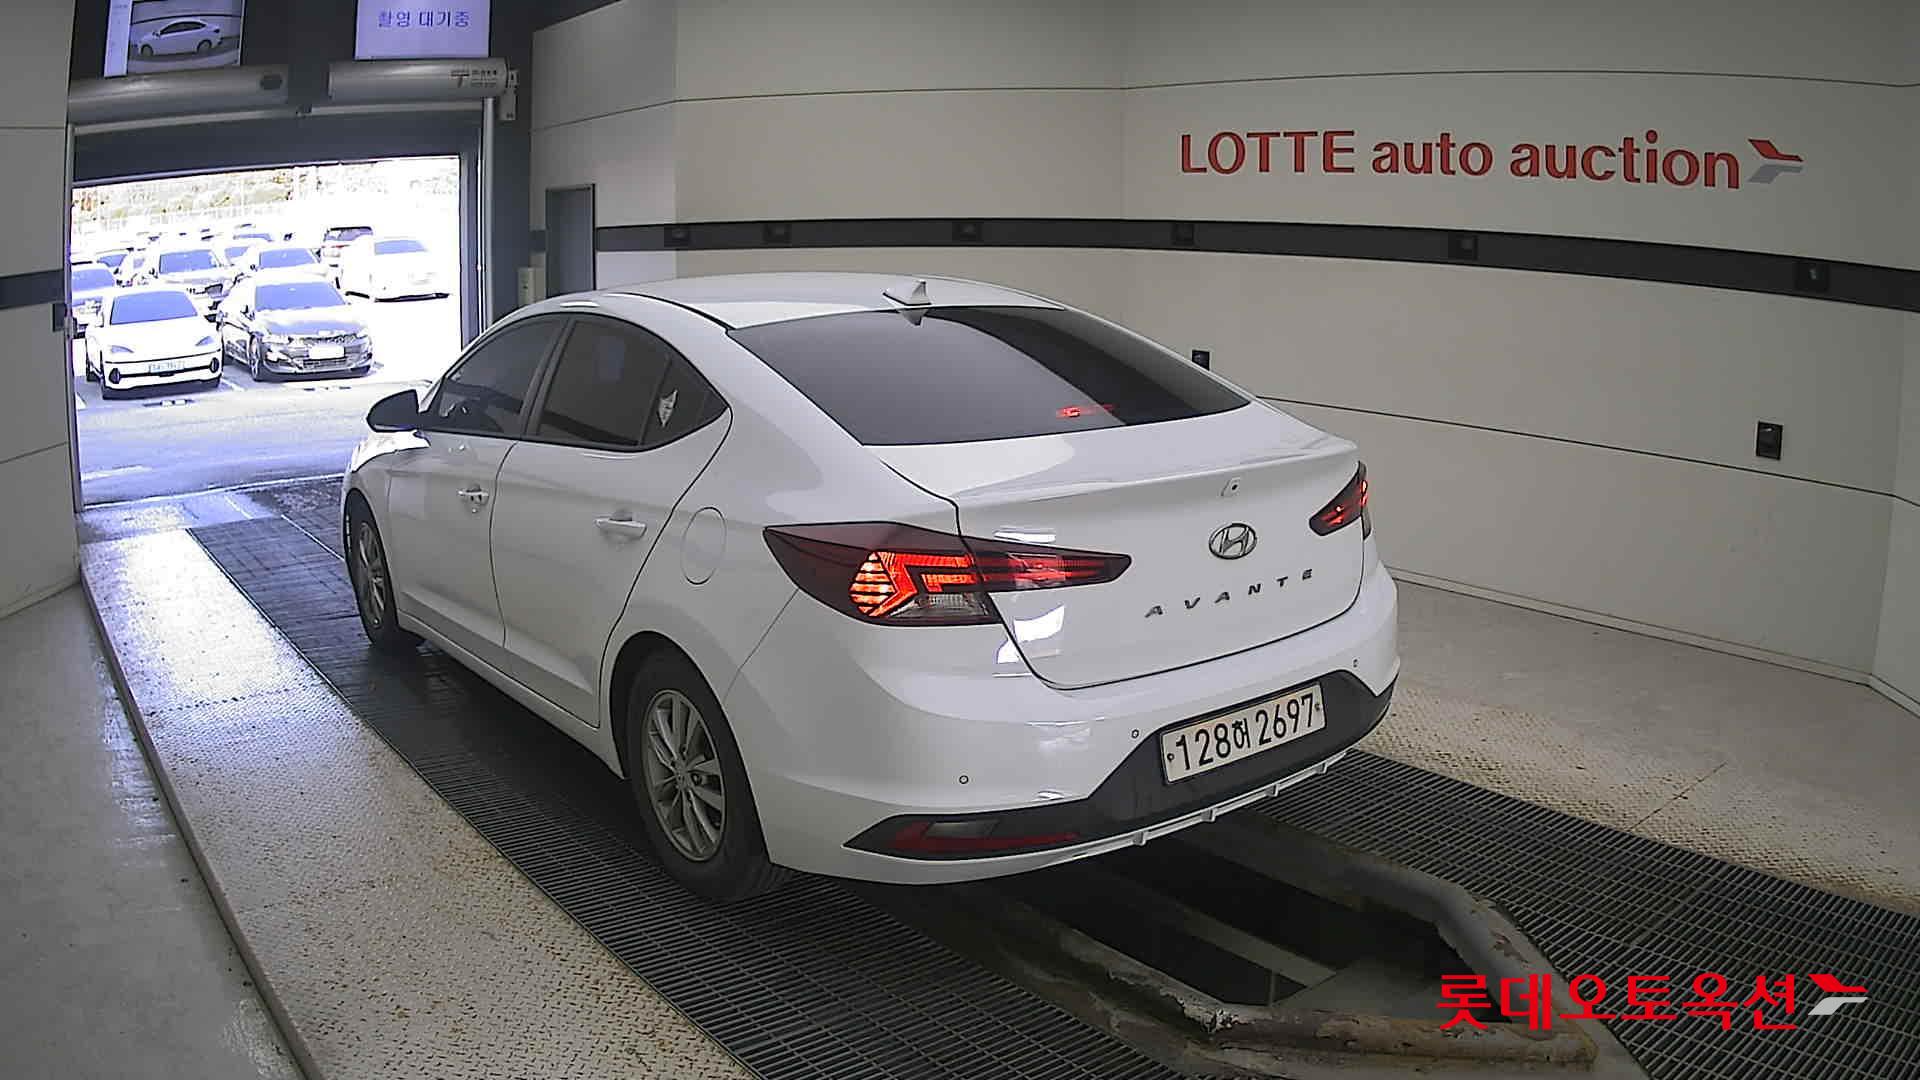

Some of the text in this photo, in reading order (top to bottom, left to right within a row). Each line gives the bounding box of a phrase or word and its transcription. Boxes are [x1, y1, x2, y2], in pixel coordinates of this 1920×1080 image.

[419, 10, 469, 28] 대기중
[1180, 130, 1740, 190] LOTTE auto auction
[1145, 569, 1313, 617] AVANTE
[1176, 693, 1314, 770] 128허 2697
